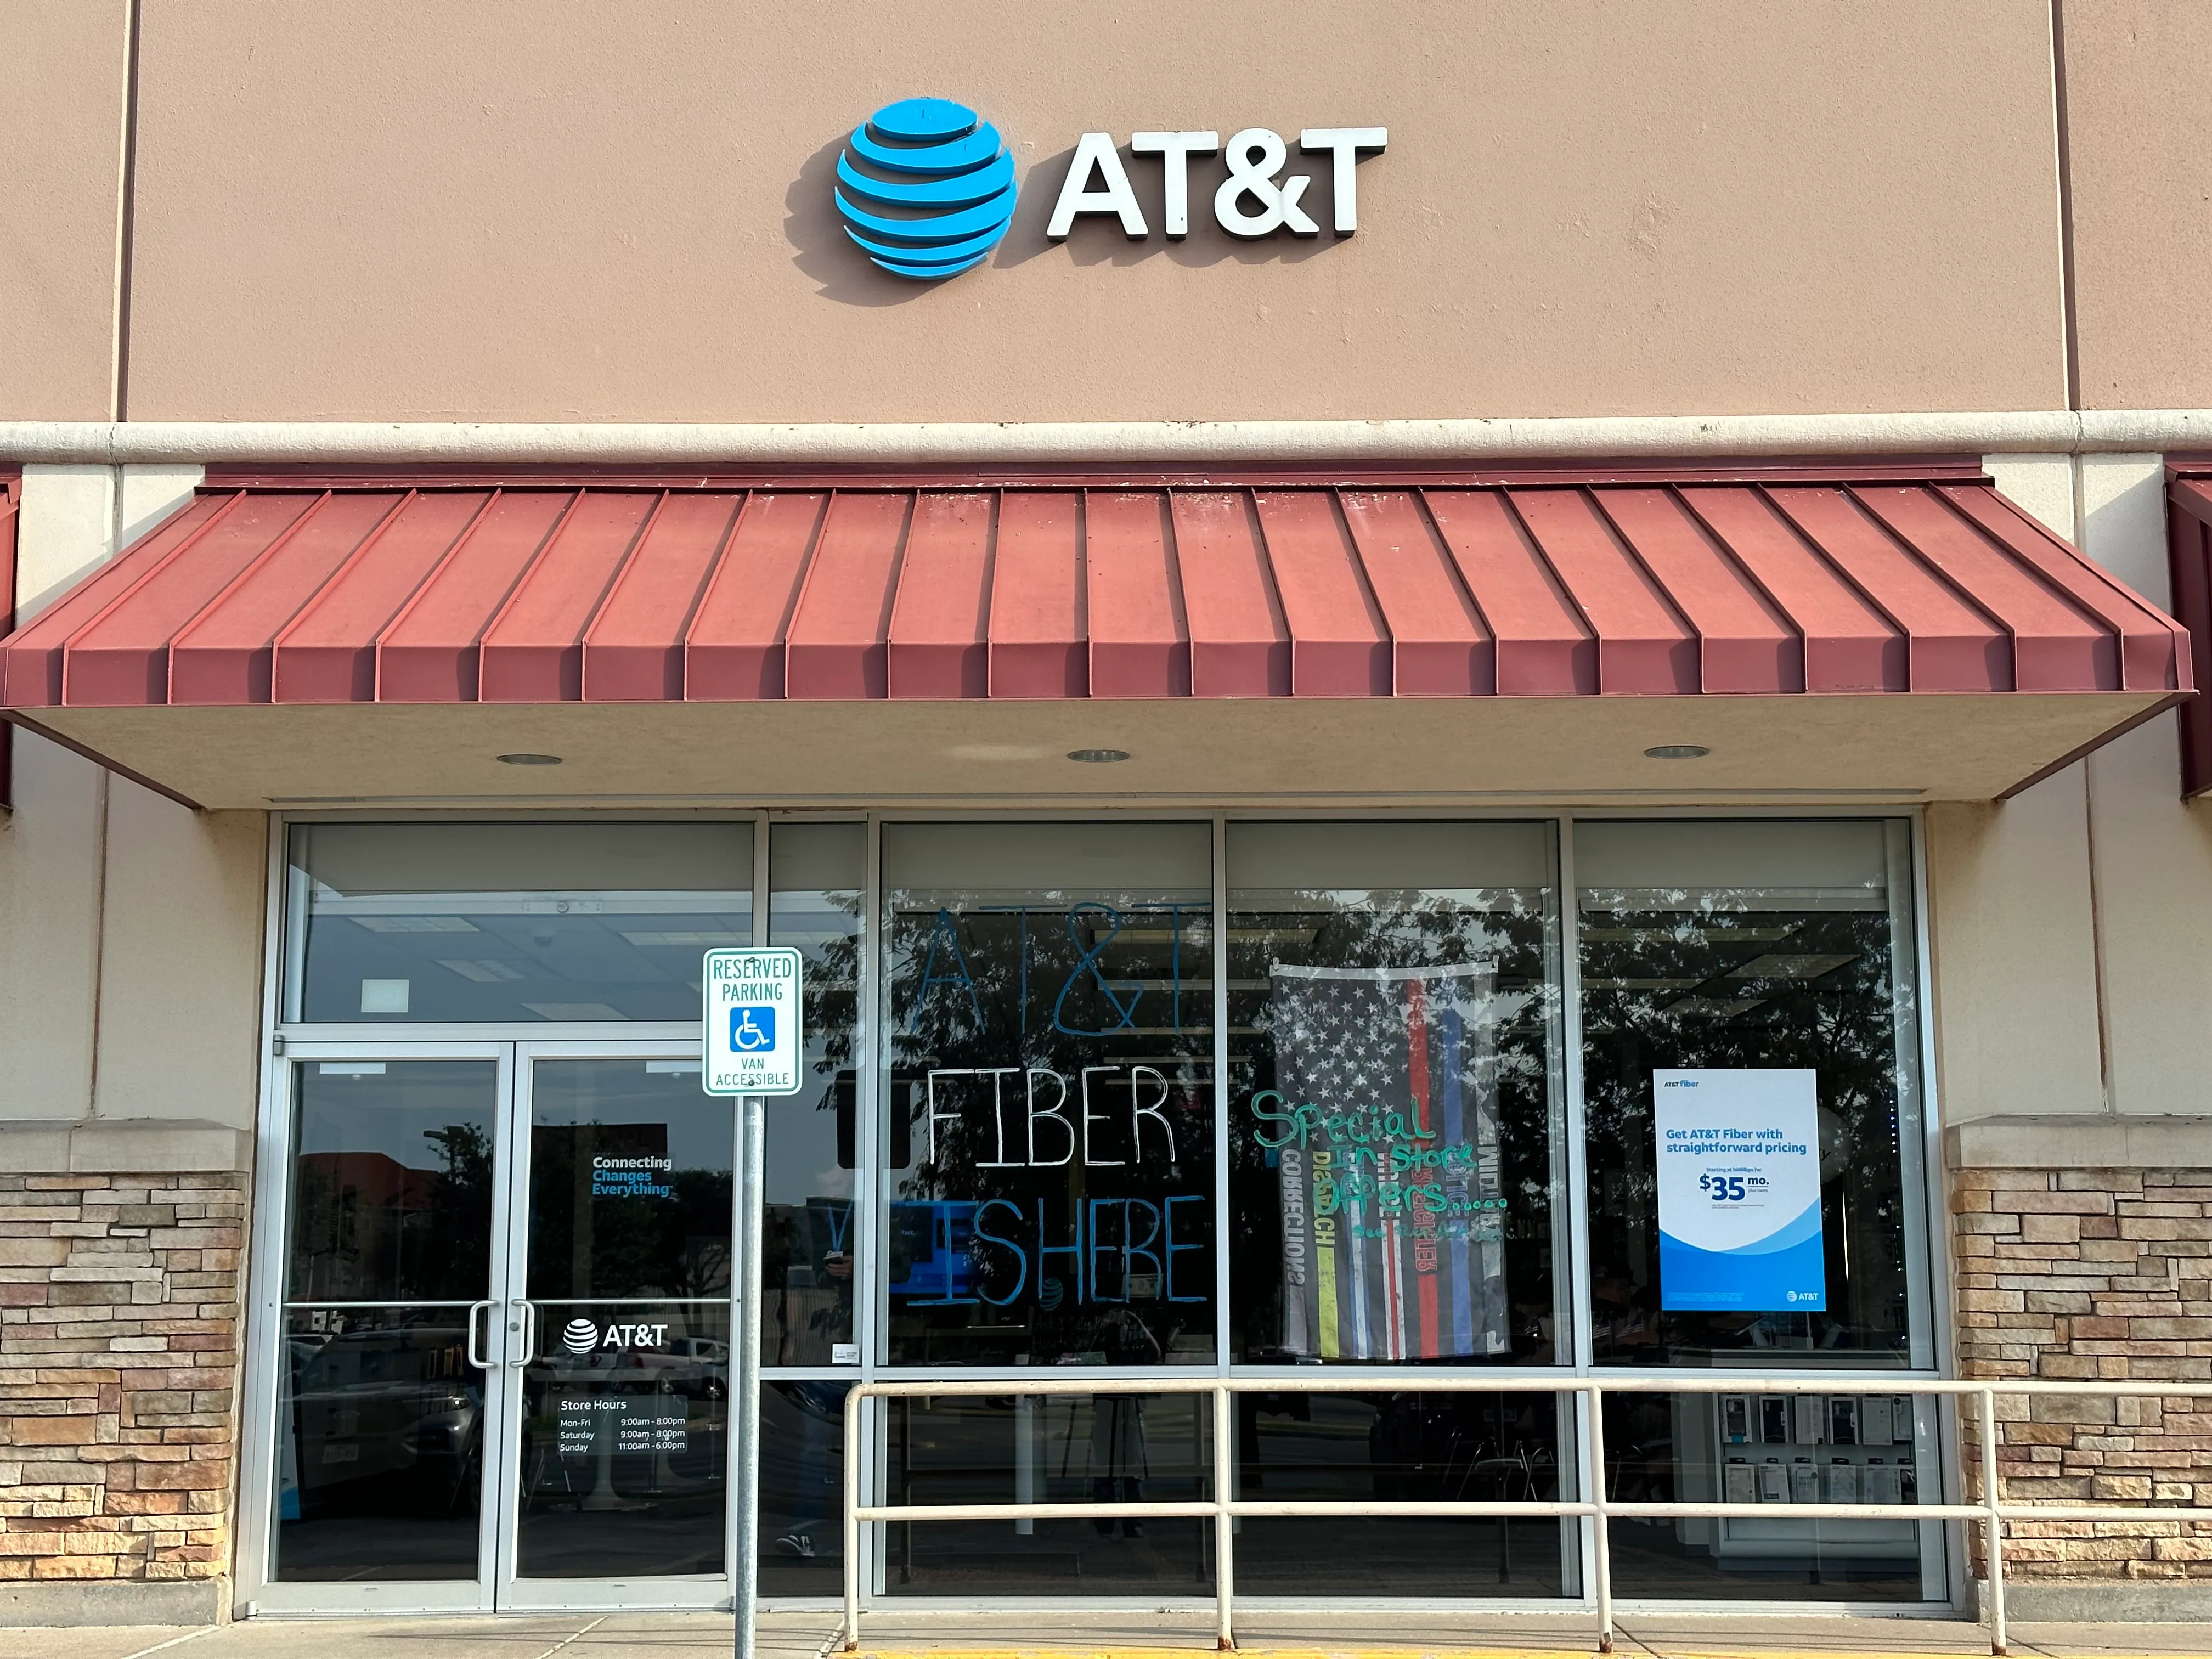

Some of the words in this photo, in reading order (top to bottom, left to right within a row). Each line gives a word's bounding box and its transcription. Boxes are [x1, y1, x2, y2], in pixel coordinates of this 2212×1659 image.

[1046, 127, 1388, 241] AT&T
[714, 958, 791, 979] RESERVED
[911, 902, 1211, 1036] AT&T
[723, 983, 783, 1001] PARKING
[741, 1058, 764, 1069] VAN
[716, 1073, 789, 1086] ACCESSIBLE
[927, 1066, 1175, 1166] FIBER
[1251, 1090, 1436, 1149] Special
[1666, 1129, 1688, 1139] Get
[1690, 1129, 1720, 1139] AT&T
[1723, 1128, 1753, 1139] Fiber
[1754, 1128, 1783, 1139] with
[1667, 1142, 1763, 1155] straightforward
[1765, 1142, 1807, 1155] pricing
[1327, 1143, 1378, 1169] In
[593, 1156, 672, 1171] Connecting
[592, 1170, 652, 1184] Changes
[1700, 1173, 1745, 1201] $35
[1798, 1293, 1818, 1301] AT&T
[602, 1324, 668, 1347] AT&T
[561, 1401, 591, 1410] Store
[594, 1400, 627, 1410] Hours
[620, 1418, 650, 1426] 9:00am
[656, 1417, 685, 1426] 8:00pm
[560, 1431, 595, 1440] Saturday
[620, 1431, 650, 1439] 9:00am
[656, 1430, 685, 1439] 8:00pm
[560, 1443, 588, 1453] Sunday
[656, 1441, 685, 1451] 6:00pm
